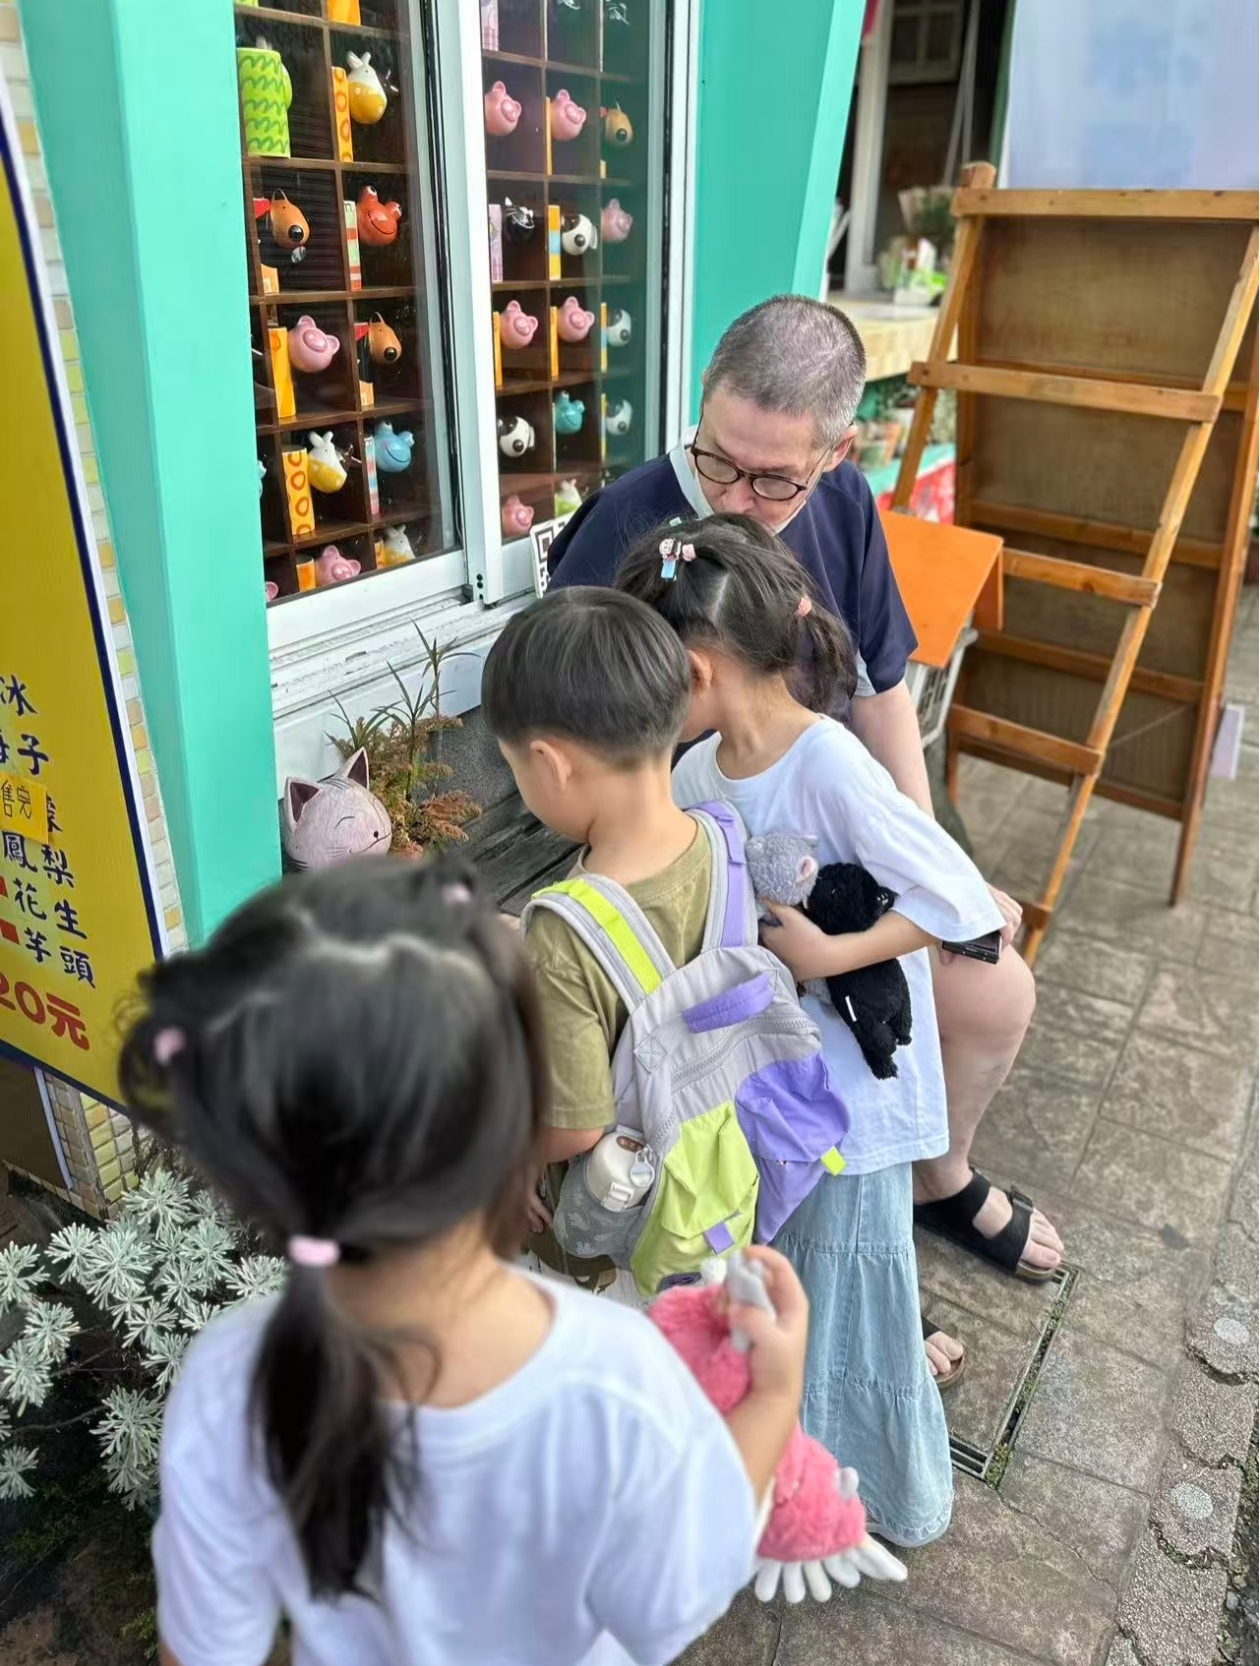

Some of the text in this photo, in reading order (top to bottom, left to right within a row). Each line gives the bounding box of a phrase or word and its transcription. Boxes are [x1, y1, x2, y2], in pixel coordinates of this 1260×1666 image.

[2, 830, 75, 888] 鳳梨
[13, 877, 88, 940] 花生
[24, 926, 96, 989] 芋頭
